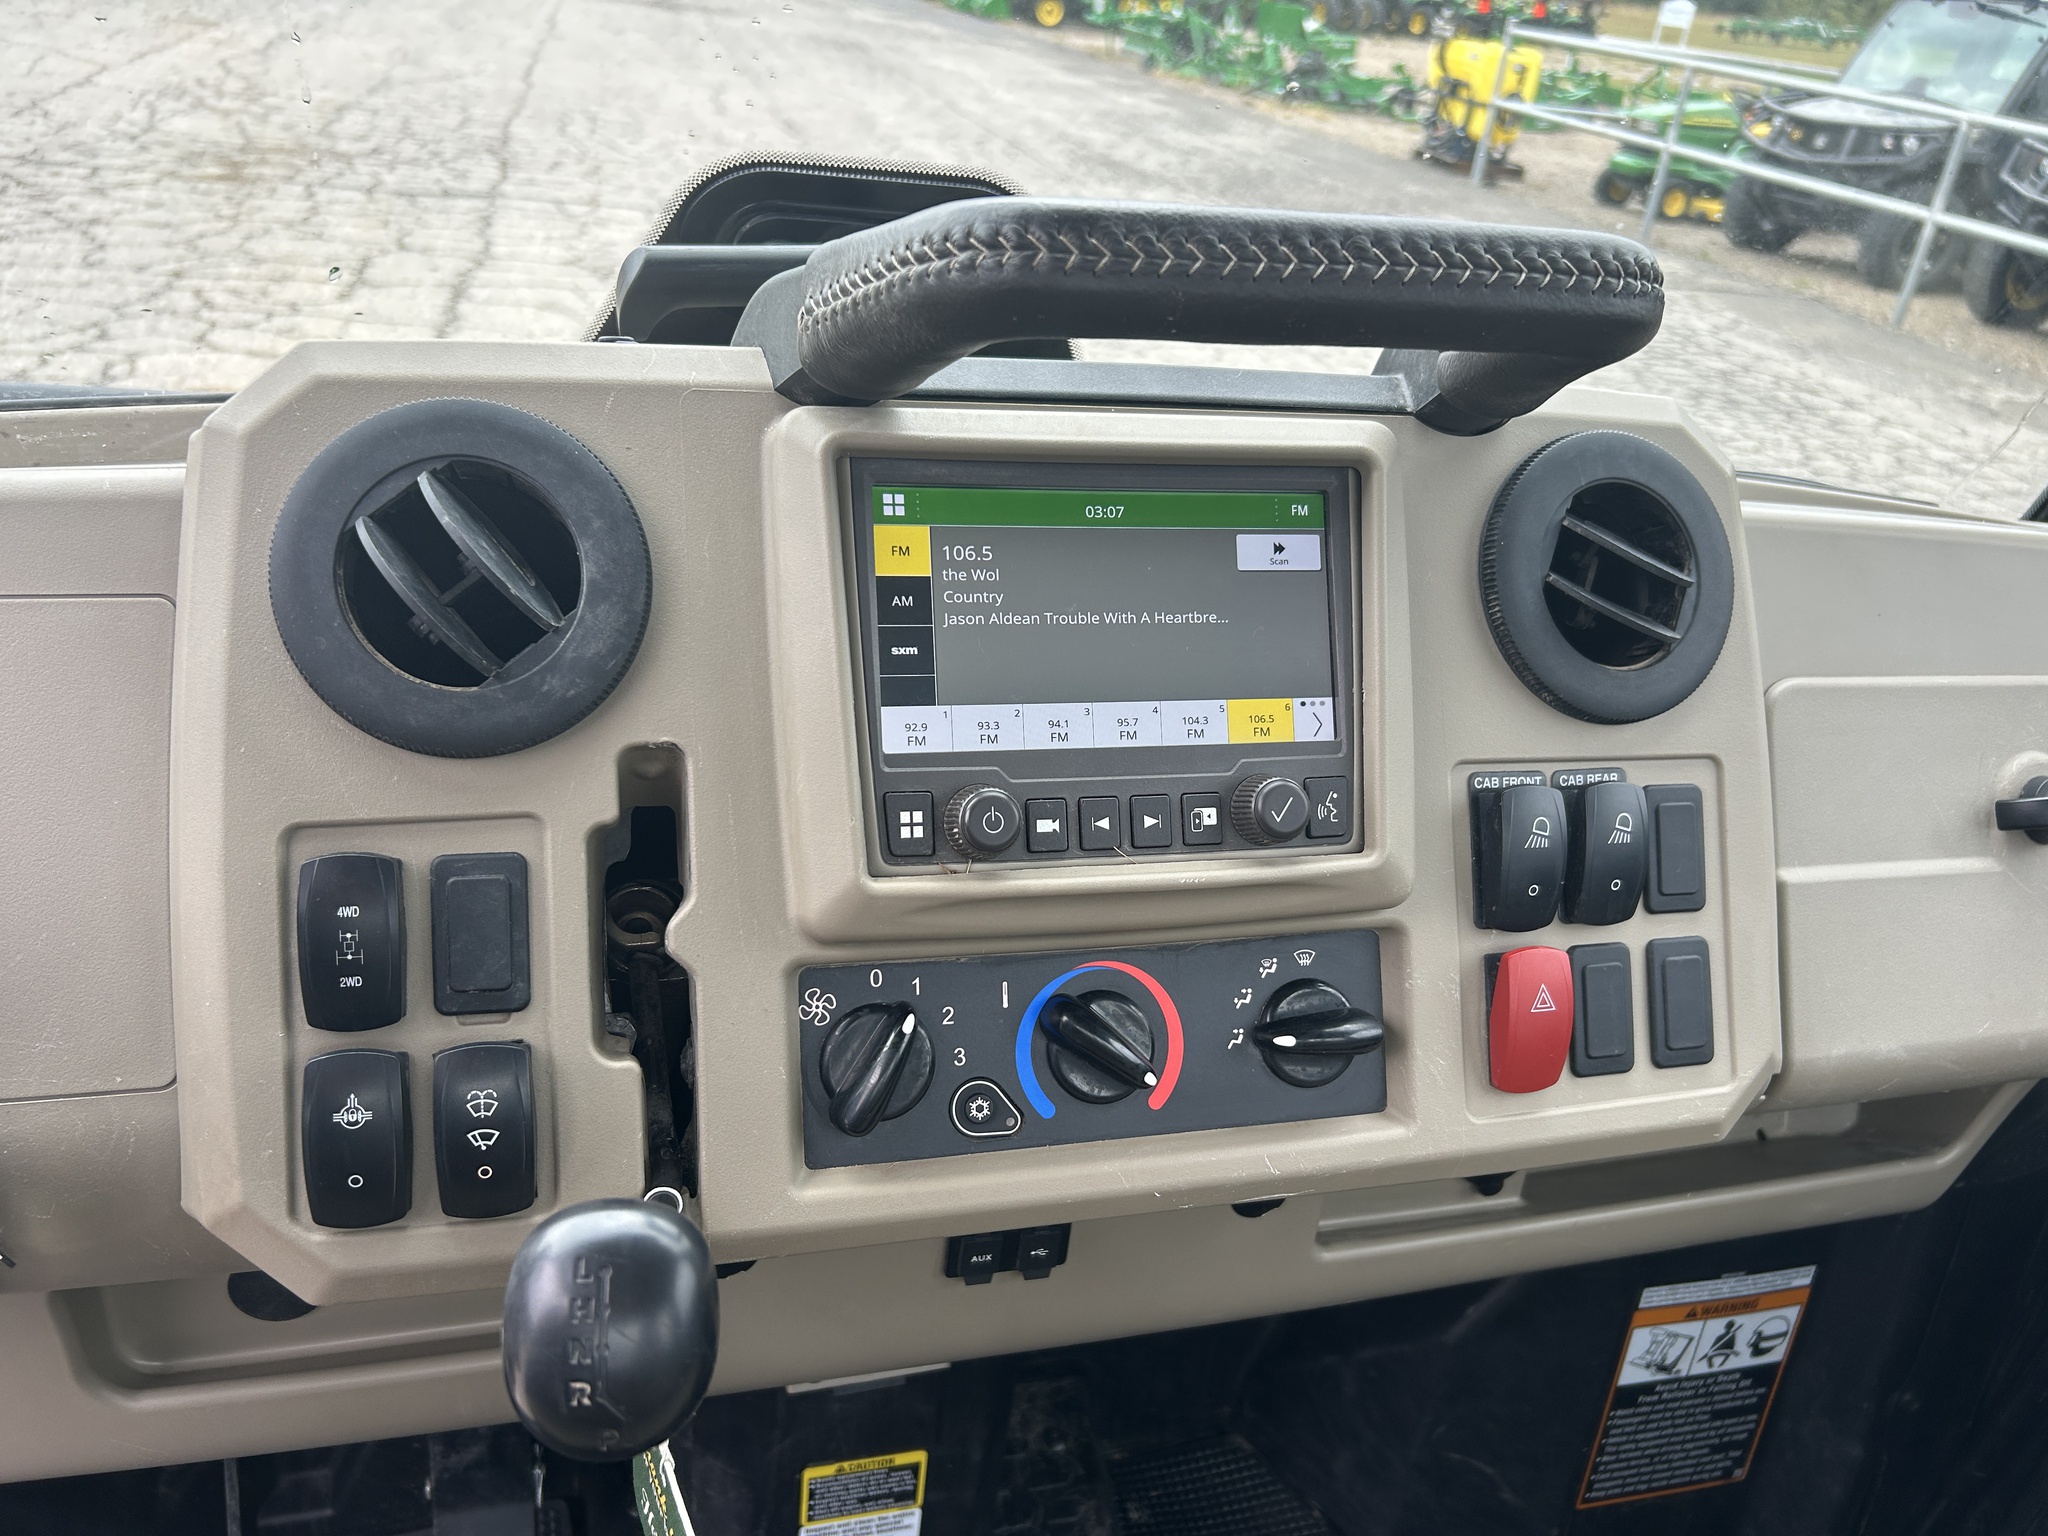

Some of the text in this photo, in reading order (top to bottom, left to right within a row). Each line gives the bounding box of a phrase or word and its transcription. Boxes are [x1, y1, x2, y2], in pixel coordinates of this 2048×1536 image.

[1085, 505, 1125, 519] 03:07
[1291, 504, 1309, 517] FM
[891, 545, 910, 557] FM
[942, 545, 993, 561] 106.5
[1269, 557, 1289, 566] Scan
[941, 567, 1000, 582] the Wol
[891, 595, 914, 607] AM
[943, 590, 1004, 607] Country
[942, 612, 985, 628] Jason
[988, 611, 1040, 625] Aldean
[1043, 611, 1100, 625] Trouble
[1103, 611, 1137, 625] With
[1140, 611, 1151, 624] A
[890, 646, 919, 656] sxm
[1014, 708, 1021, 718] 2
[1084, 707, 1091, 716] 3
[1152, 706, 1159, 715] 4
[1219, 704, 1225, 713] 5
[1284, 702, 1291, 712] 6
[942, 710, 948, 719] 1
[1182, 715, 1209, 726] 104.3
[1248, 714, 1275, 724] 106.5
[904, 722, 928, 733] 92.9
[977, 721, 1000, 731] 93.3
[1047, 719, 1069, 729] 94.1
[1116, 717, 1139, 727] 95.7
[1050, 731, 1069, 743] FM
[1119, 730, 1138, 741] FM
[1187, 728, 1205, 739] FM
[1253, 726, 1271, 737] FM
[907, 735, 927, 747] FM
[980, 733, 999, 745] FM
[1475, 776, 1542, 788] CAB FRONT
[1560, 773, 1618, 786] CAB REAR
[337, 906, 359, 917] 4WD
[340, 977, 362, 987] 2WD
[870, 969, 882, 987] 0
[912, 977, 919, 995] 1
[942, 1007, 954, 1024] 2
[954, 1048, 965, 1066] 3
[970, 1253, 993, 1263] AUX
[576, 1256, 594, 1284] L
[571, 1297, 595, 1324] H
[1700, 1297, 1761, 1317] WARNING
[569, 1337, 592, 1365] N
[569, 1381, 592, 1407] R
